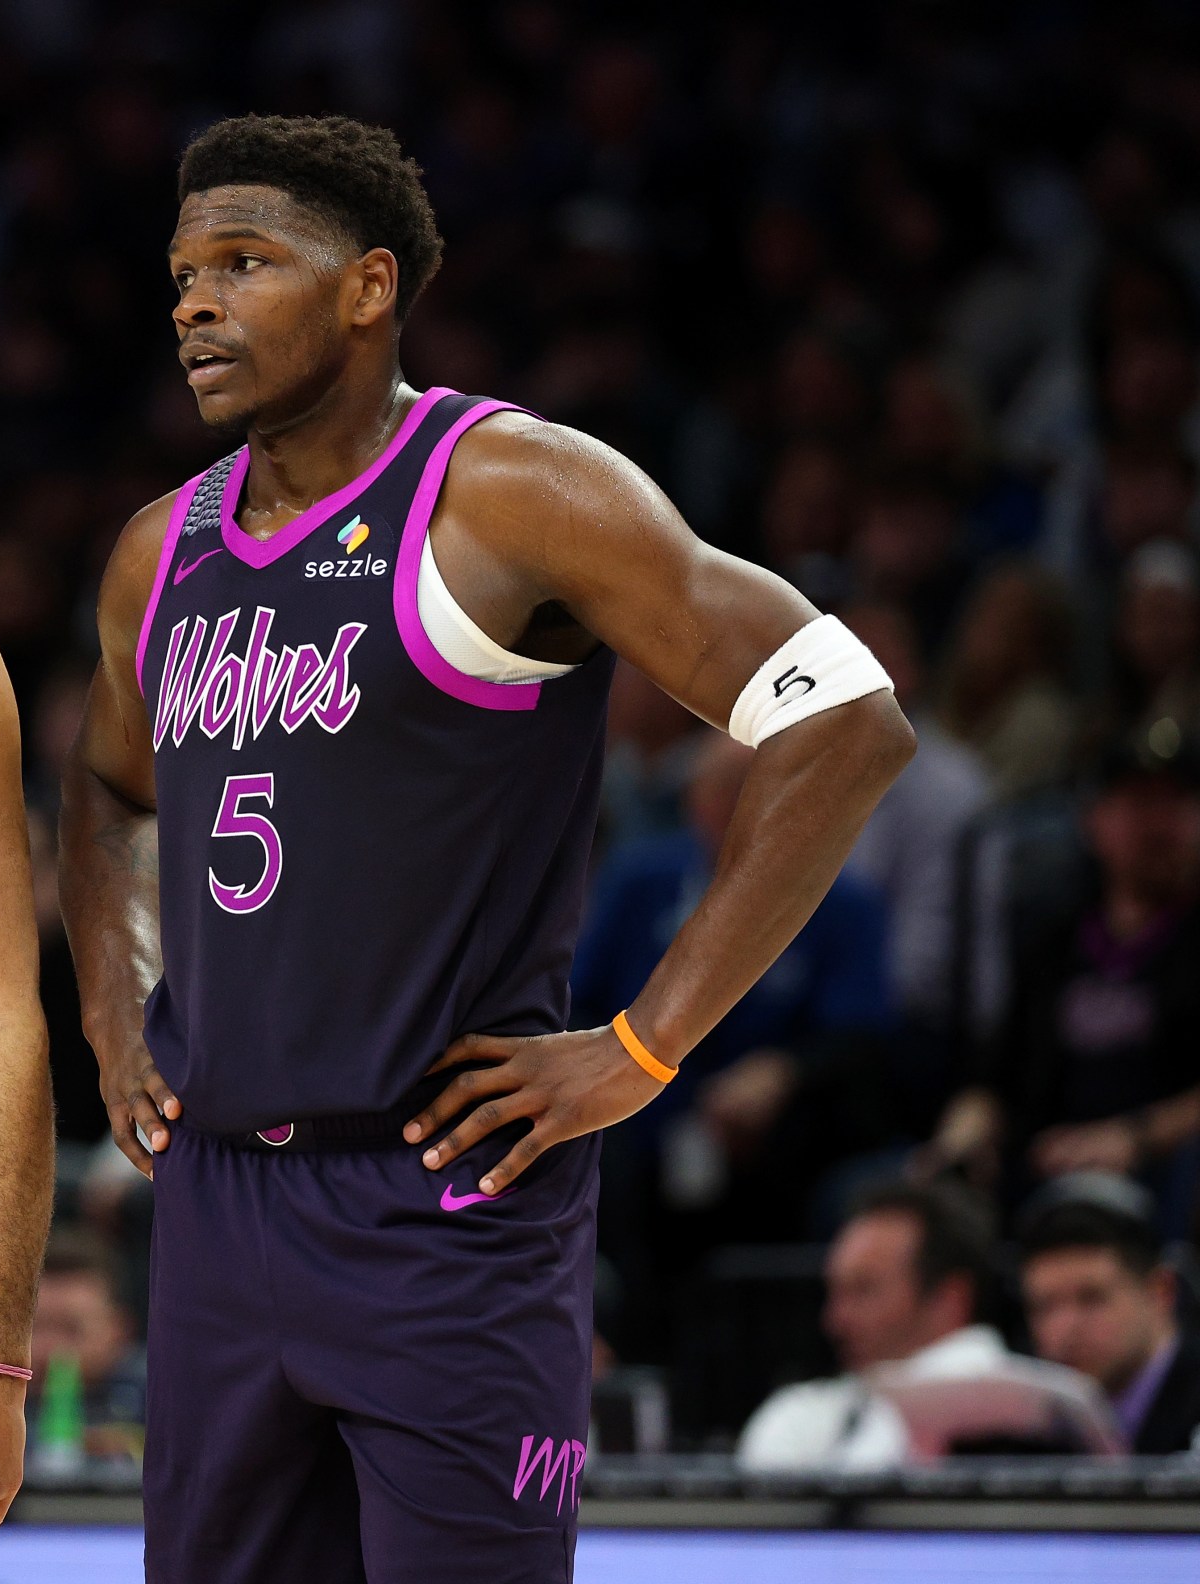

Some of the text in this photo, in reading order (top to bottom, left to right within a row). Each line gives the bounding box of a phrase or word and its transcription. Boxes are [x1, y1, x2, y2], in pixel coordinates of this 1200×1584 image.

[304, 553, 388, 578] sezzle
[153, 606, 368, 753] Wolves
[773, 665, 816, 707] 5
[208, 772, 283, 914] 5
[512, 1435, 586, 1517] MP
